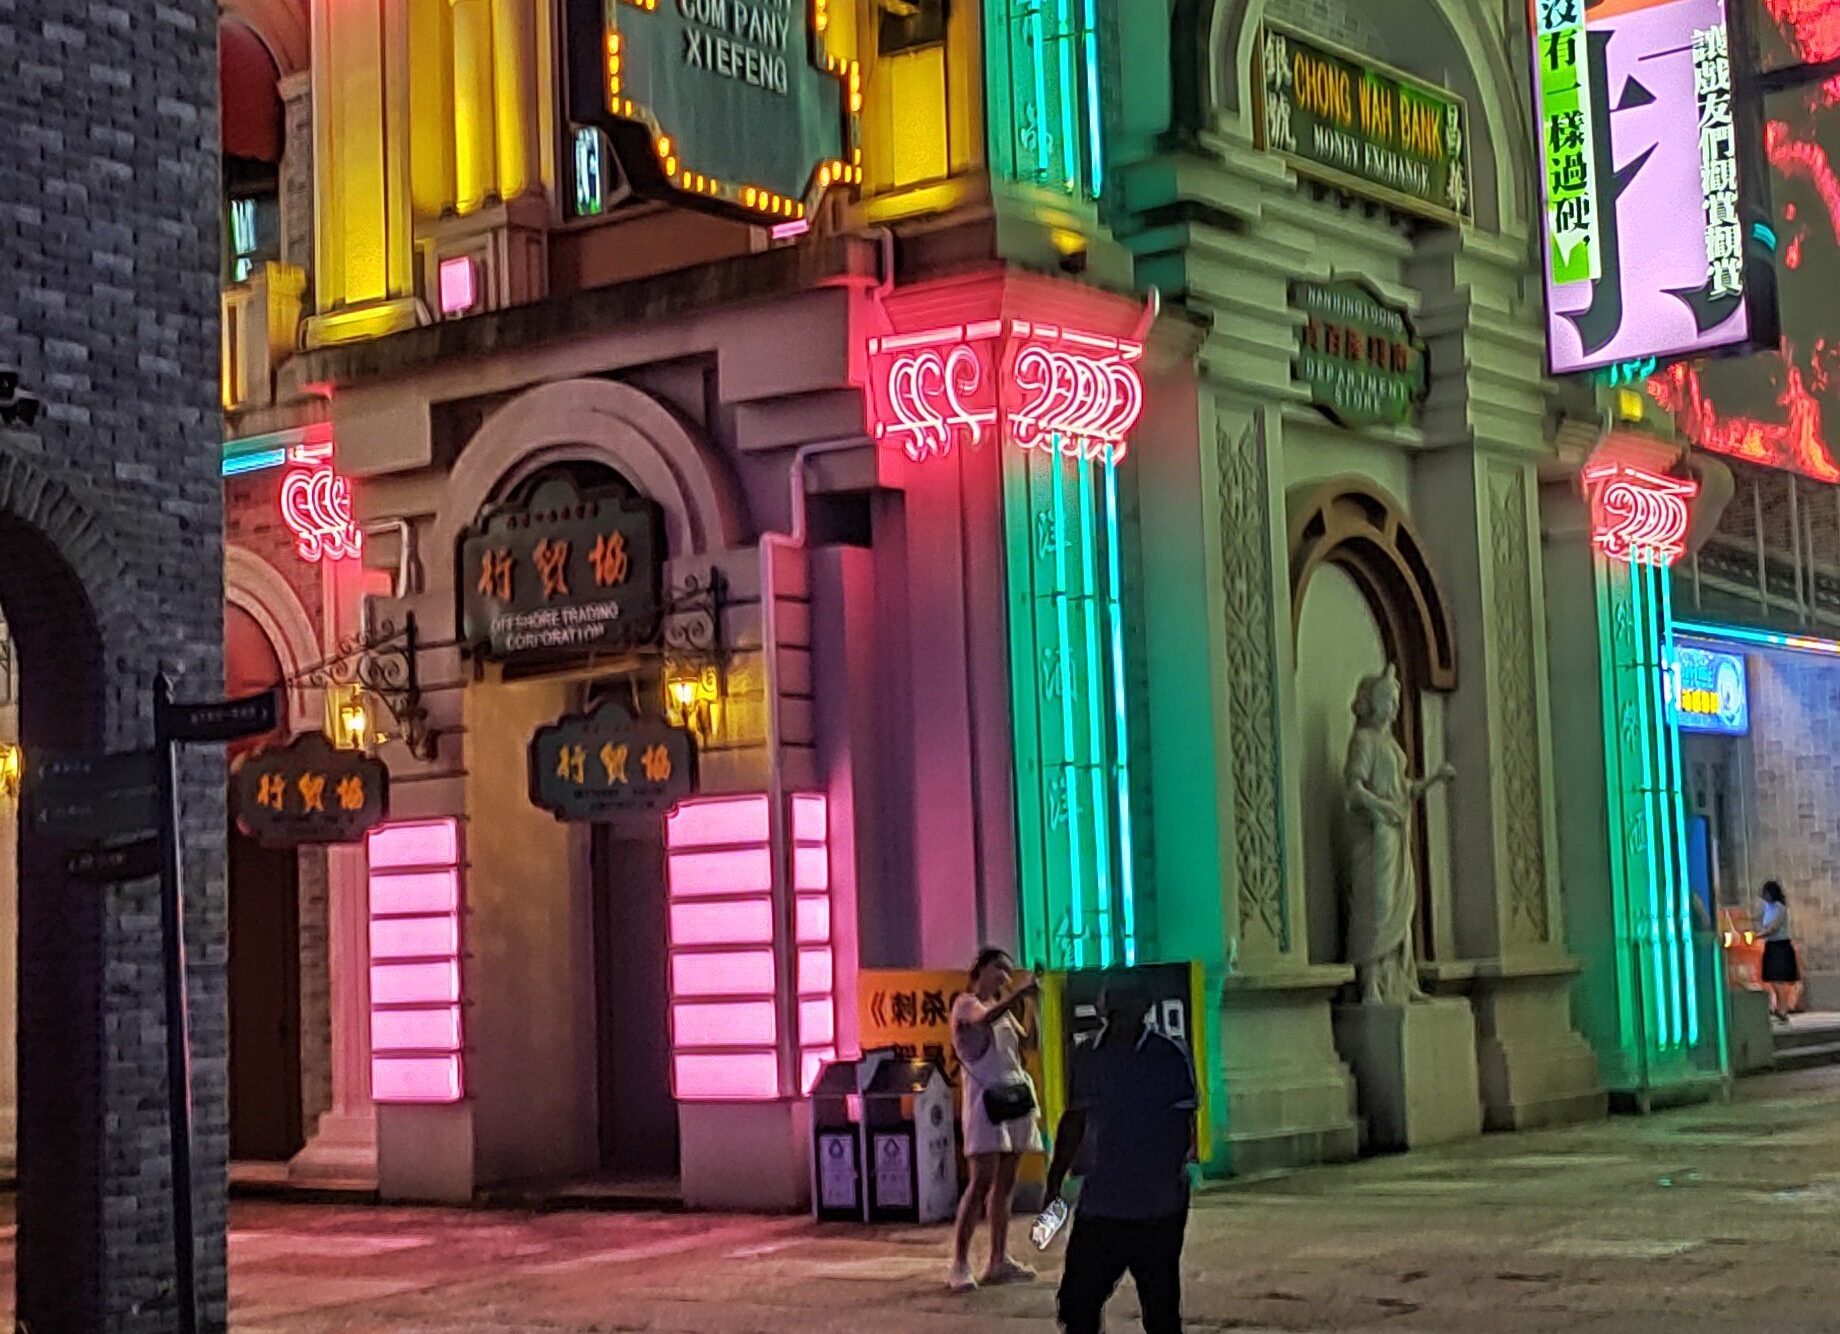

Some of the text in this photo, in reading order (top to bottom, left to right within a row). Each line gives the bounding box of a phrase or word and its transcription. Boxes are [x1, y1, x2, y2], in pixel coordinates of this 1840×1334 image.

[686, 26, 787, 96] XIEFENG
[1294, 50, 1444, 162] CHONG WAH BANK
[1313, 123, 1359, 169] MONEY
